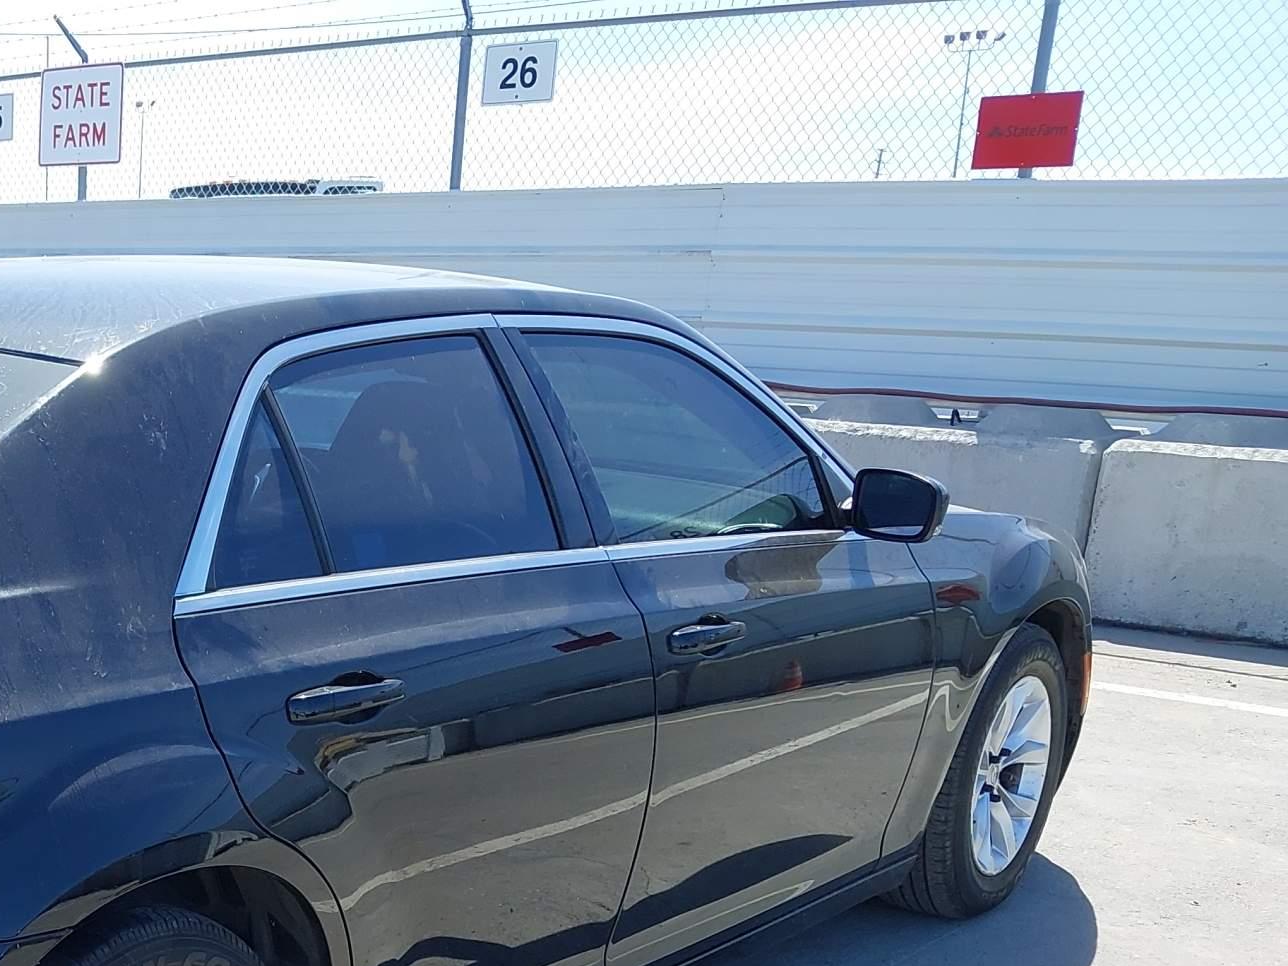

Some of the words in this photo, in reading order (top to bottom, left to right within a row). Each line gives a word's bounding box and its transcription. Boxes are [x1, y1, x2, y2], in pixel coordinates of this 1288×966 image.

[500, 56, 538, 89] 26
[52, 82, 110, 110] STATE
[53, 122, 105, 149] FARM
